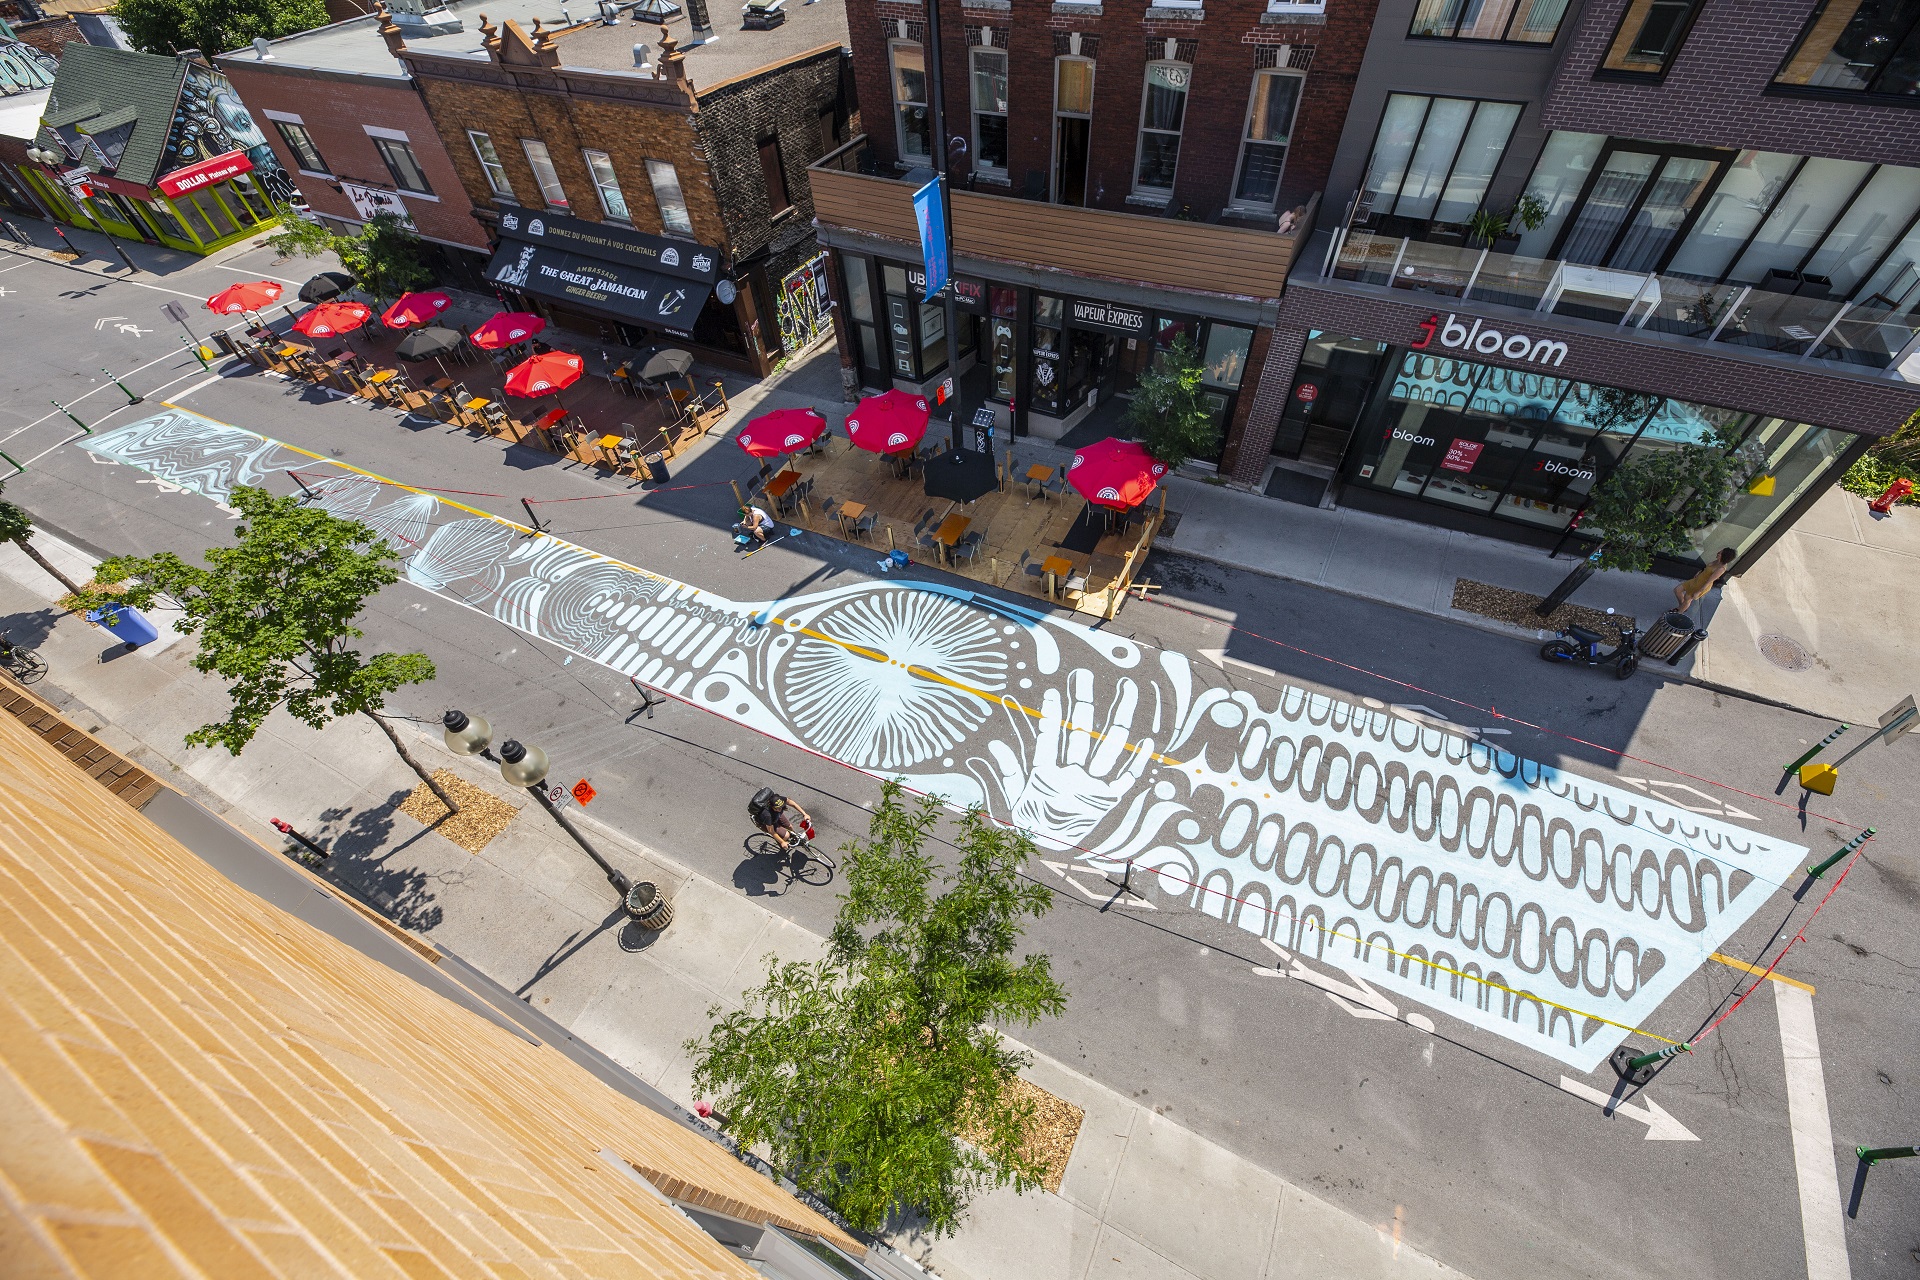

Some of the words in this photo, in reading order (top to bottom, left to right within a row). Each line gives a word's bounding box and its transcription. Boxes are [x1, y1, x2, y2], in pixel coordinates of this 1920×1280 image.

[176, 173, 208, 190] DOLLAR
[351, 187, 364, 203] Le
[548, 226, 571, 238] DONNEZ
[572, 231, 580, 240] DU
[581, 234, 606, 247] PIQUANT
[612, 241, 624, 250] VOS
[625, 244, 657, 257] COCKTAILS
[576, 266, 618, 281] AMBASSADE
[540, 265, 559, 278] THE
[559, 270, 594, 286] GREAT
[590, 278, 648, 300] JAMAICAN
[565, 285, 587, 298] GINGER
[585, 289, 600, 301] BEER
[1074, 304, 1105, 322] VAPEUR
[1107, 310, 1143, 328] EXPRESS
